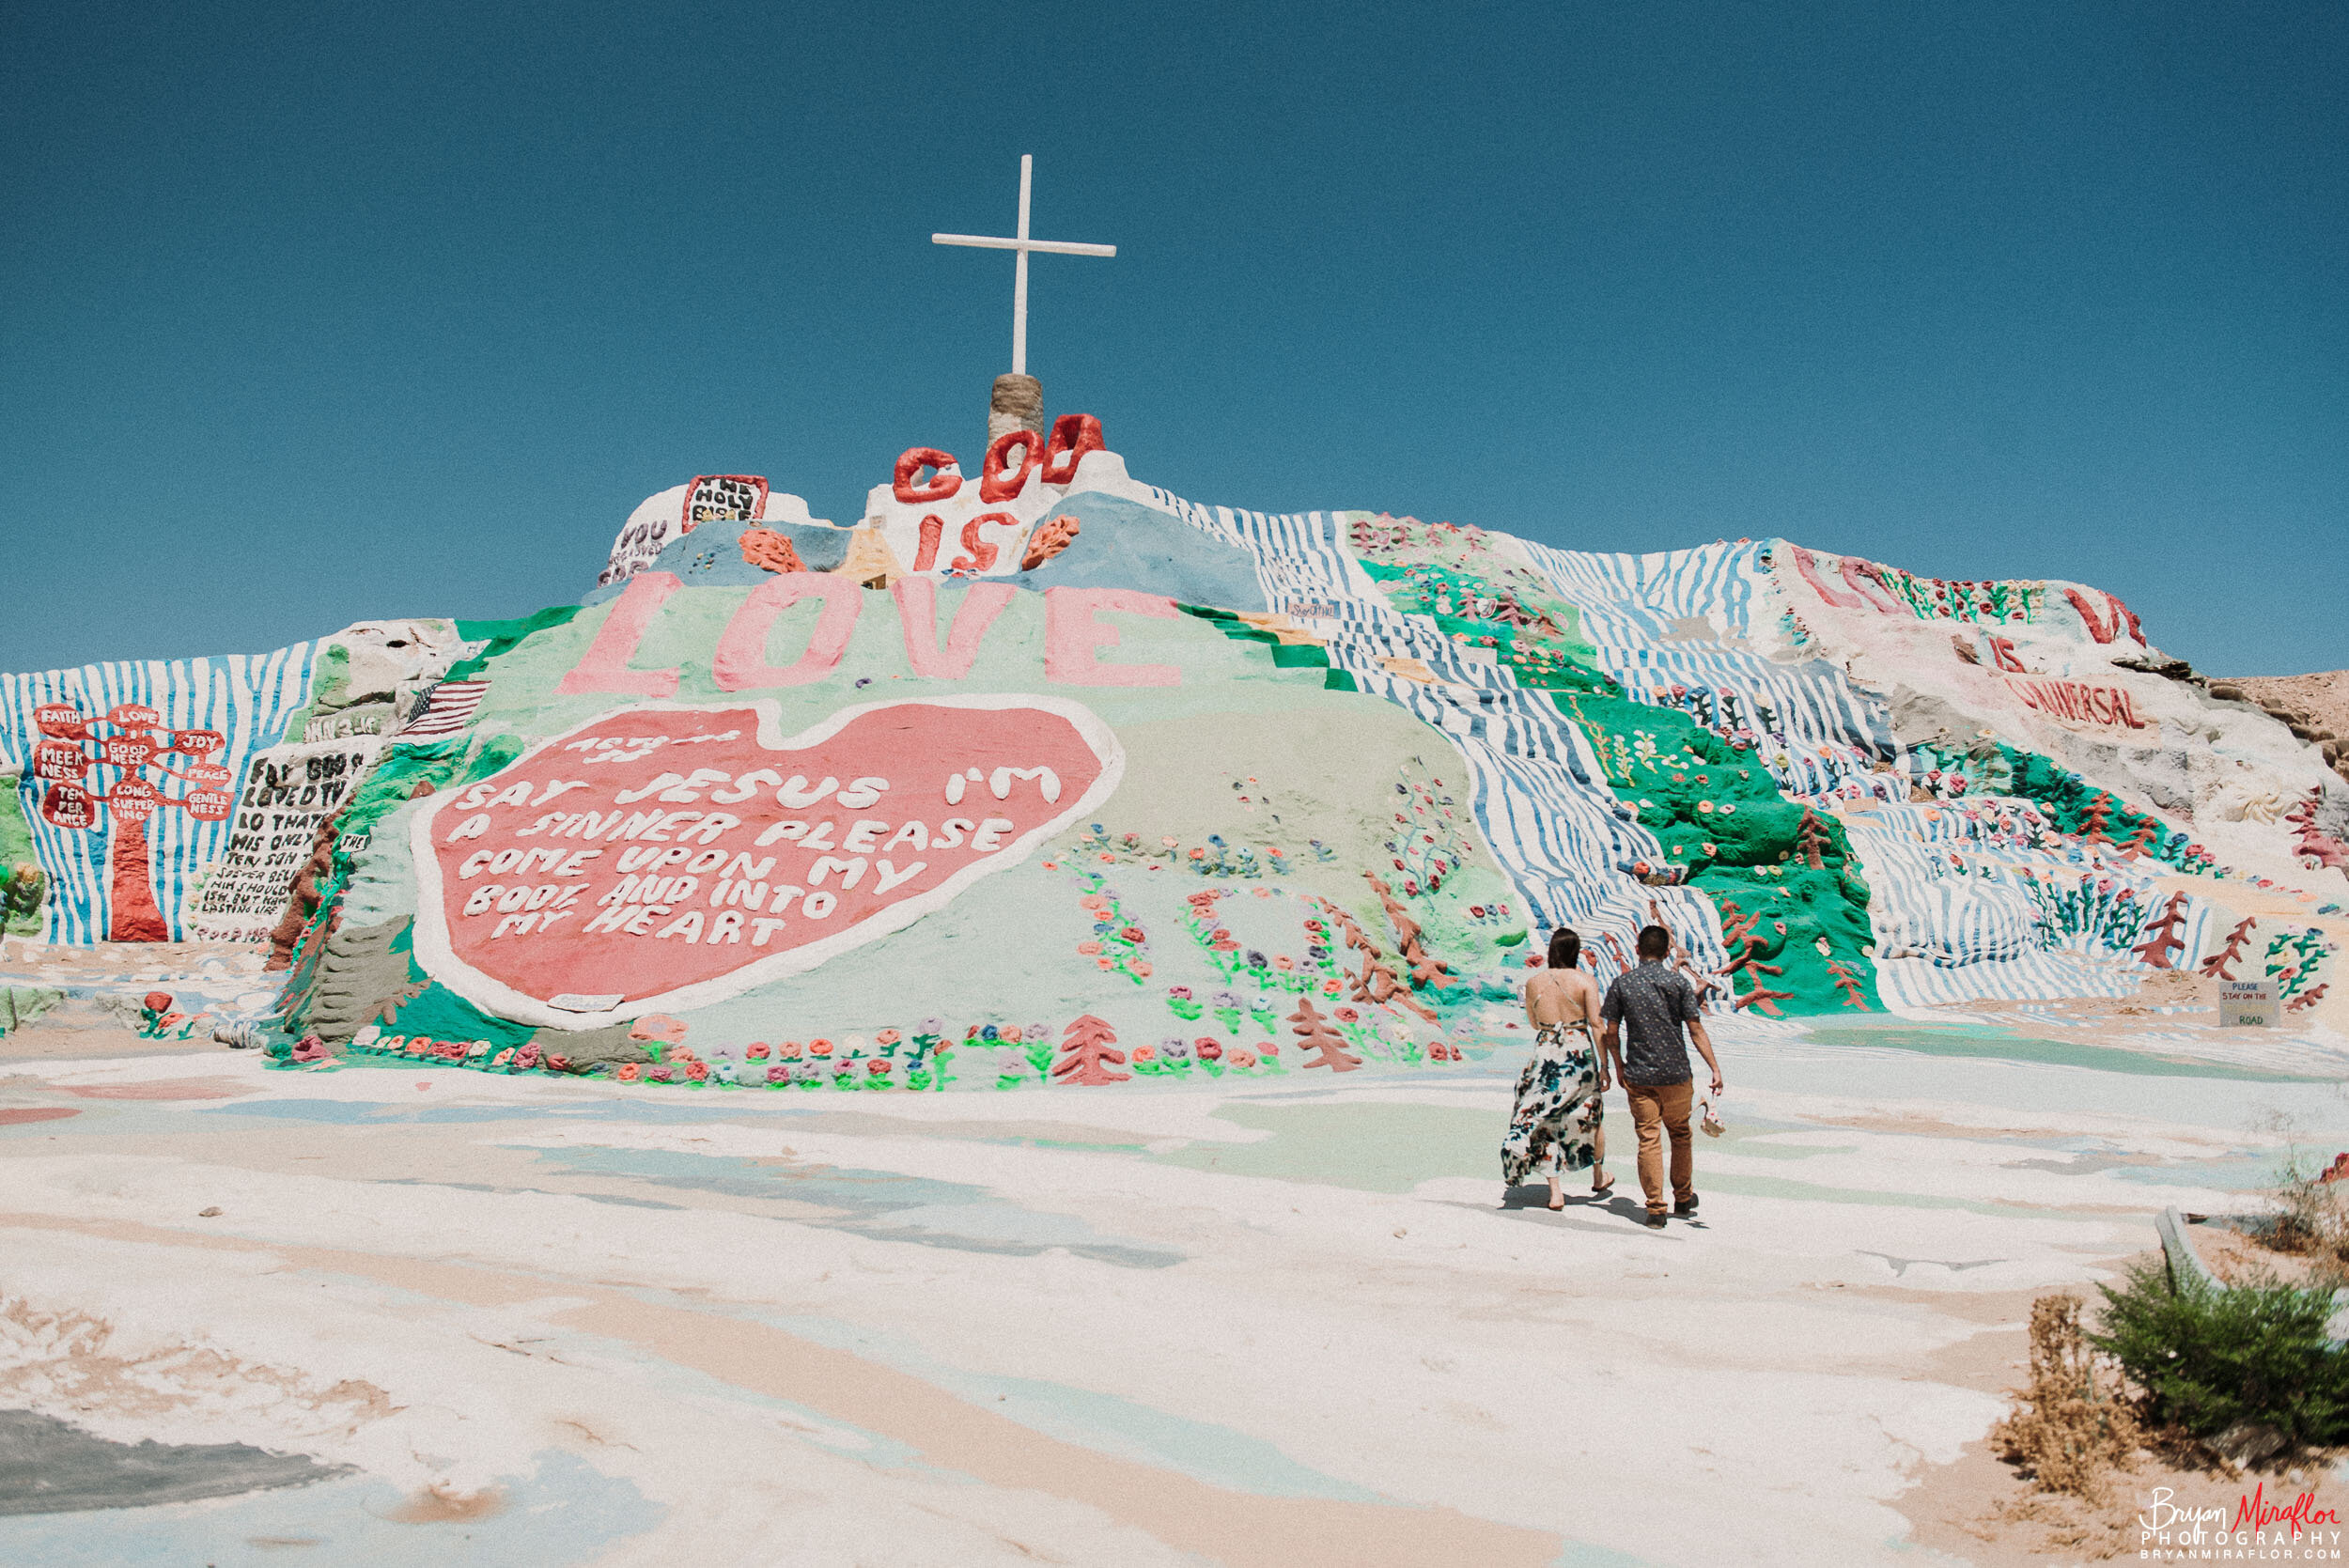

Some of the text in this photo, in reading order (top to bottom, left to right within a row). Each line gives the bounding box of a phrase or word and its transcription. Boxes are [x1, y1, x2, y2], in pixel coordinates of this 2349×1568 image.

[893, 413, 1107, 504] GOD
[702, 477, 752, 495] THE
[696, 489, 753, 509] HOLY
[692, 505, 752, 521] BIBE
[621, 520, 668, 549] YOU
[913, 512, 1019, 572] IS
[552, 571, 1182, 698] LOVE
[1989, 636, 2027, 674] IS
[2003, 677, 2145, 729] UNIVERSAL
[40, 710, 82, 724] FAITH
[118, 709, 158, 724] LOVE
[108, 742, 149, 755] GOOD
[182, 734, 219, 752] JOY
[40, 747, 85, 767] MEEK
[110, 753, 143, 765] NESS
[40, 764, 78, 779] NESS
[188, 768, 228, 781] PEACE
[58, 786, 86, 800] TEM
[117, 785, 152, 798] LONG
[456, 766, 1061, 809] SAY JESUS I'M
[112, 798, 155, 810] SUFFER
[189, 793, 228, 805] GENTLE
[118, 808, 146, 821] ING
[190, 803, 225, 815] NESS
[448, 809, 1015, 853] A SINNER PLEASE
[271, 833, 313, 850] ONLY
[264, 853, 297, 866] SON
[459, 846, 927, 895] COME UPON MY
[237, 882, 288, 896] SHOULD
[462, 874, 837, 919] BODY AND INTO
[233, 893, 260, 904] BUT
[202, 903, 251, 914] LASTING
[490, 905, 786, 946] MY HEART
[2239, 1016, 2263, 1025] ROAD
